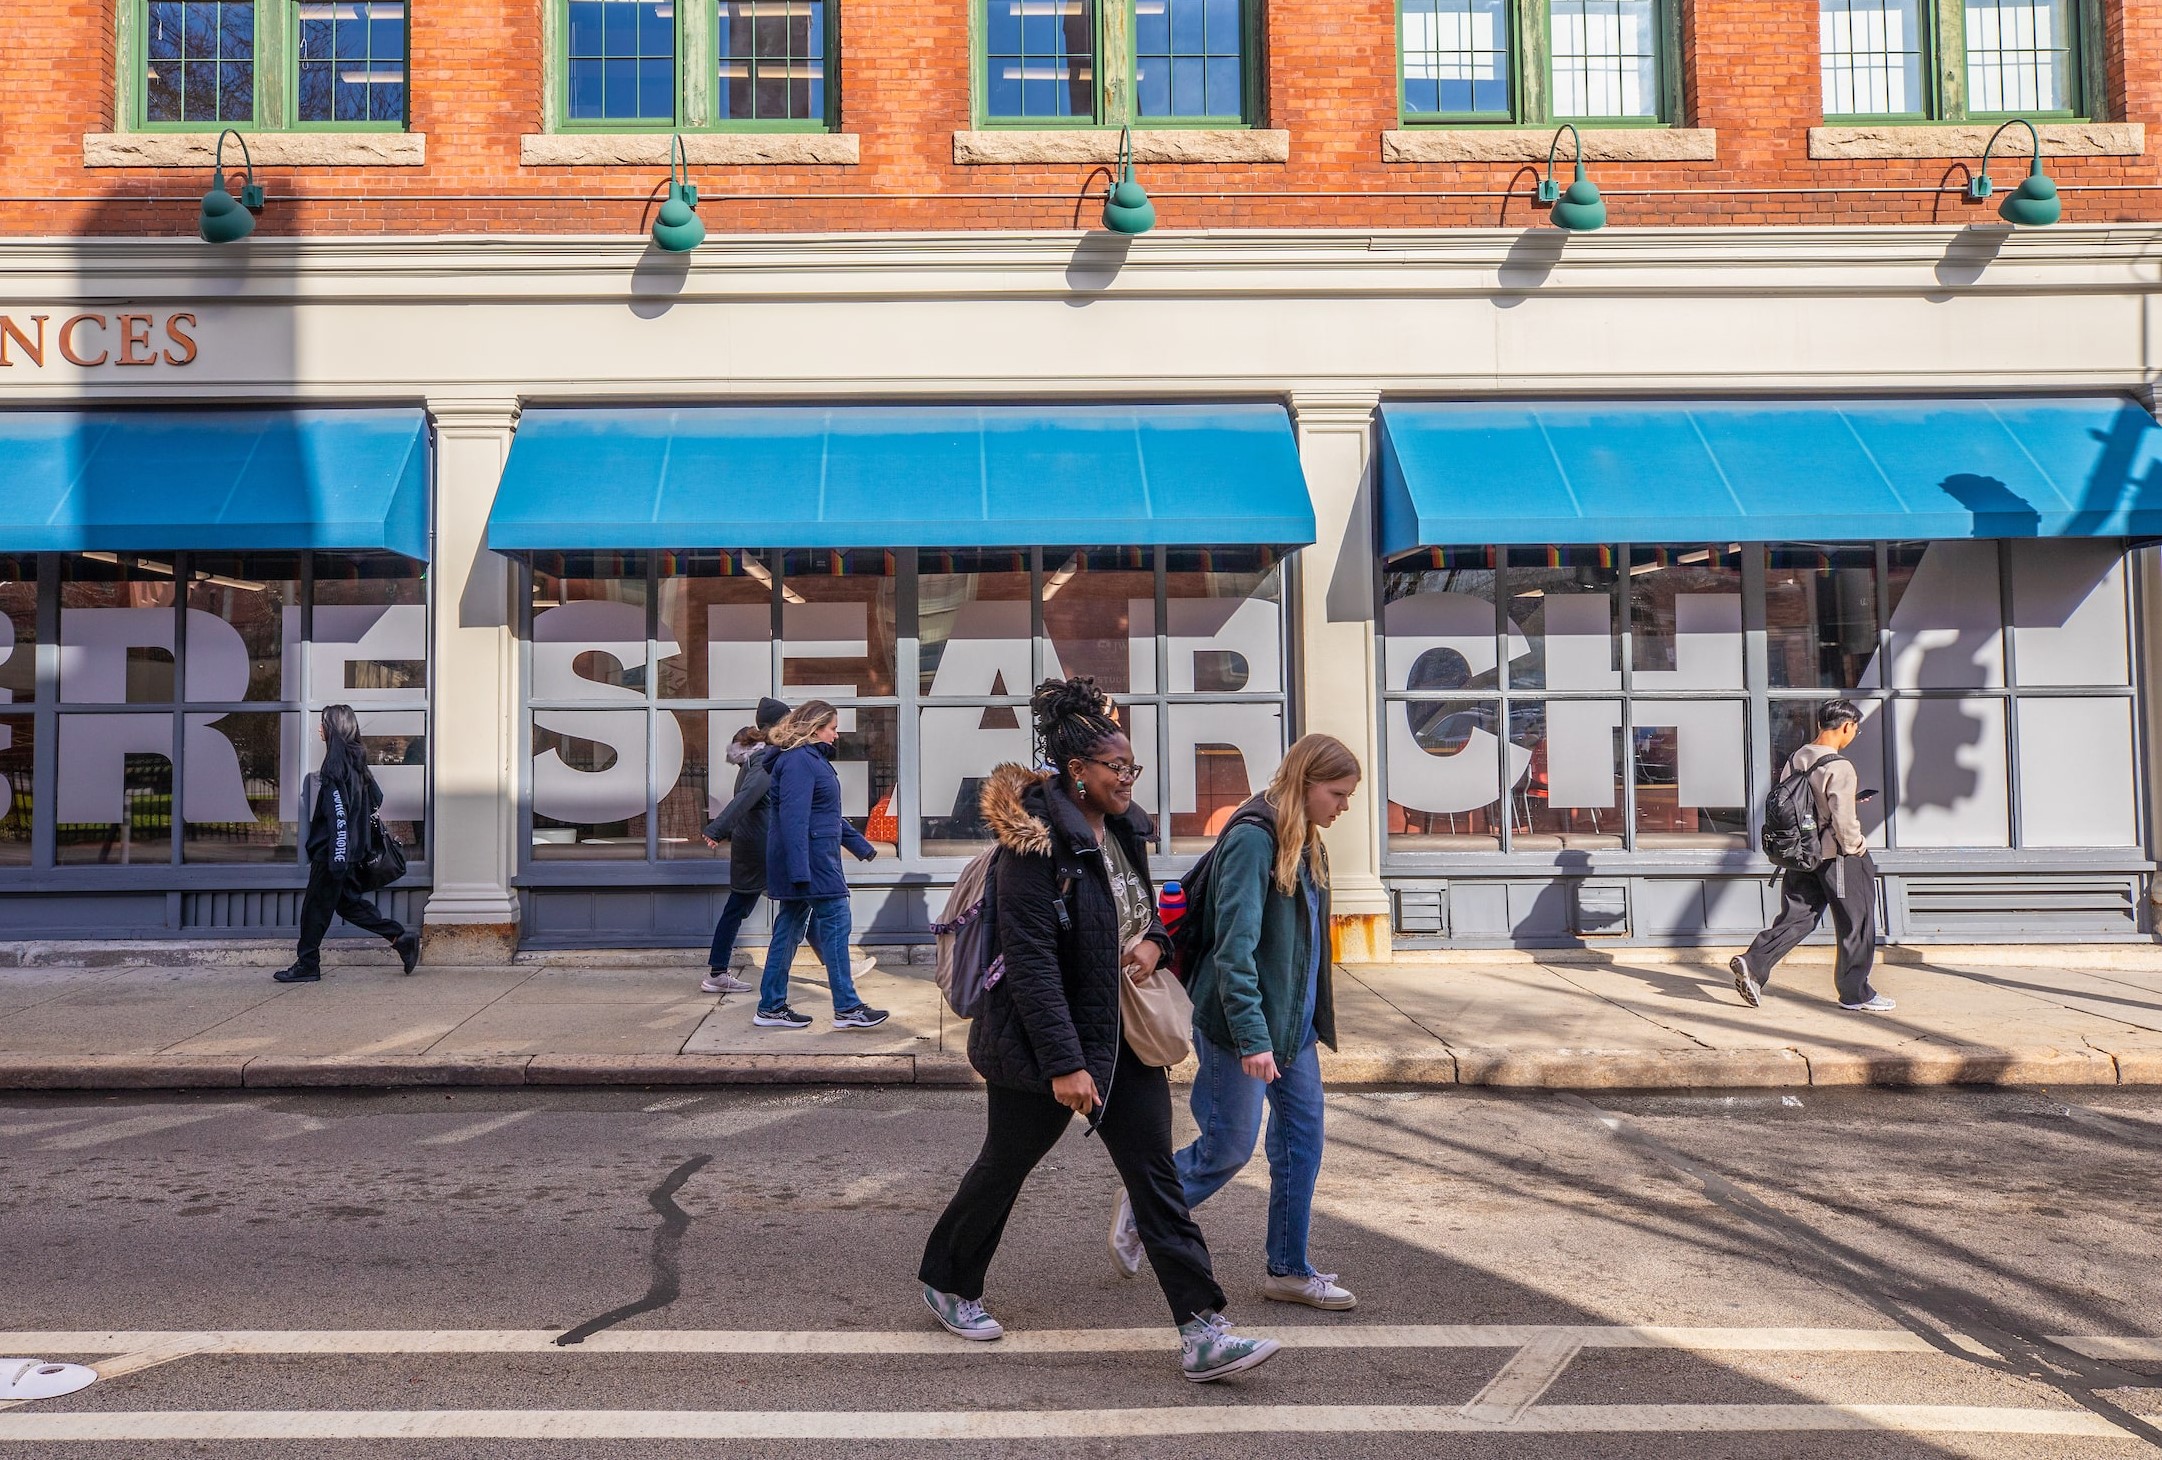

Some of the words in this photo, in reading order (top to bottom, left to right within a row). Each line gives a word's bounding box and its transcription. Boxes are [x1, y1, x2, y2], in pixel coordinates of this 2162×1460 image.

[0, 313, 198, 368] NCES
[336, 819, 347, 830] &
[334, 830, 347, 863] MORE
